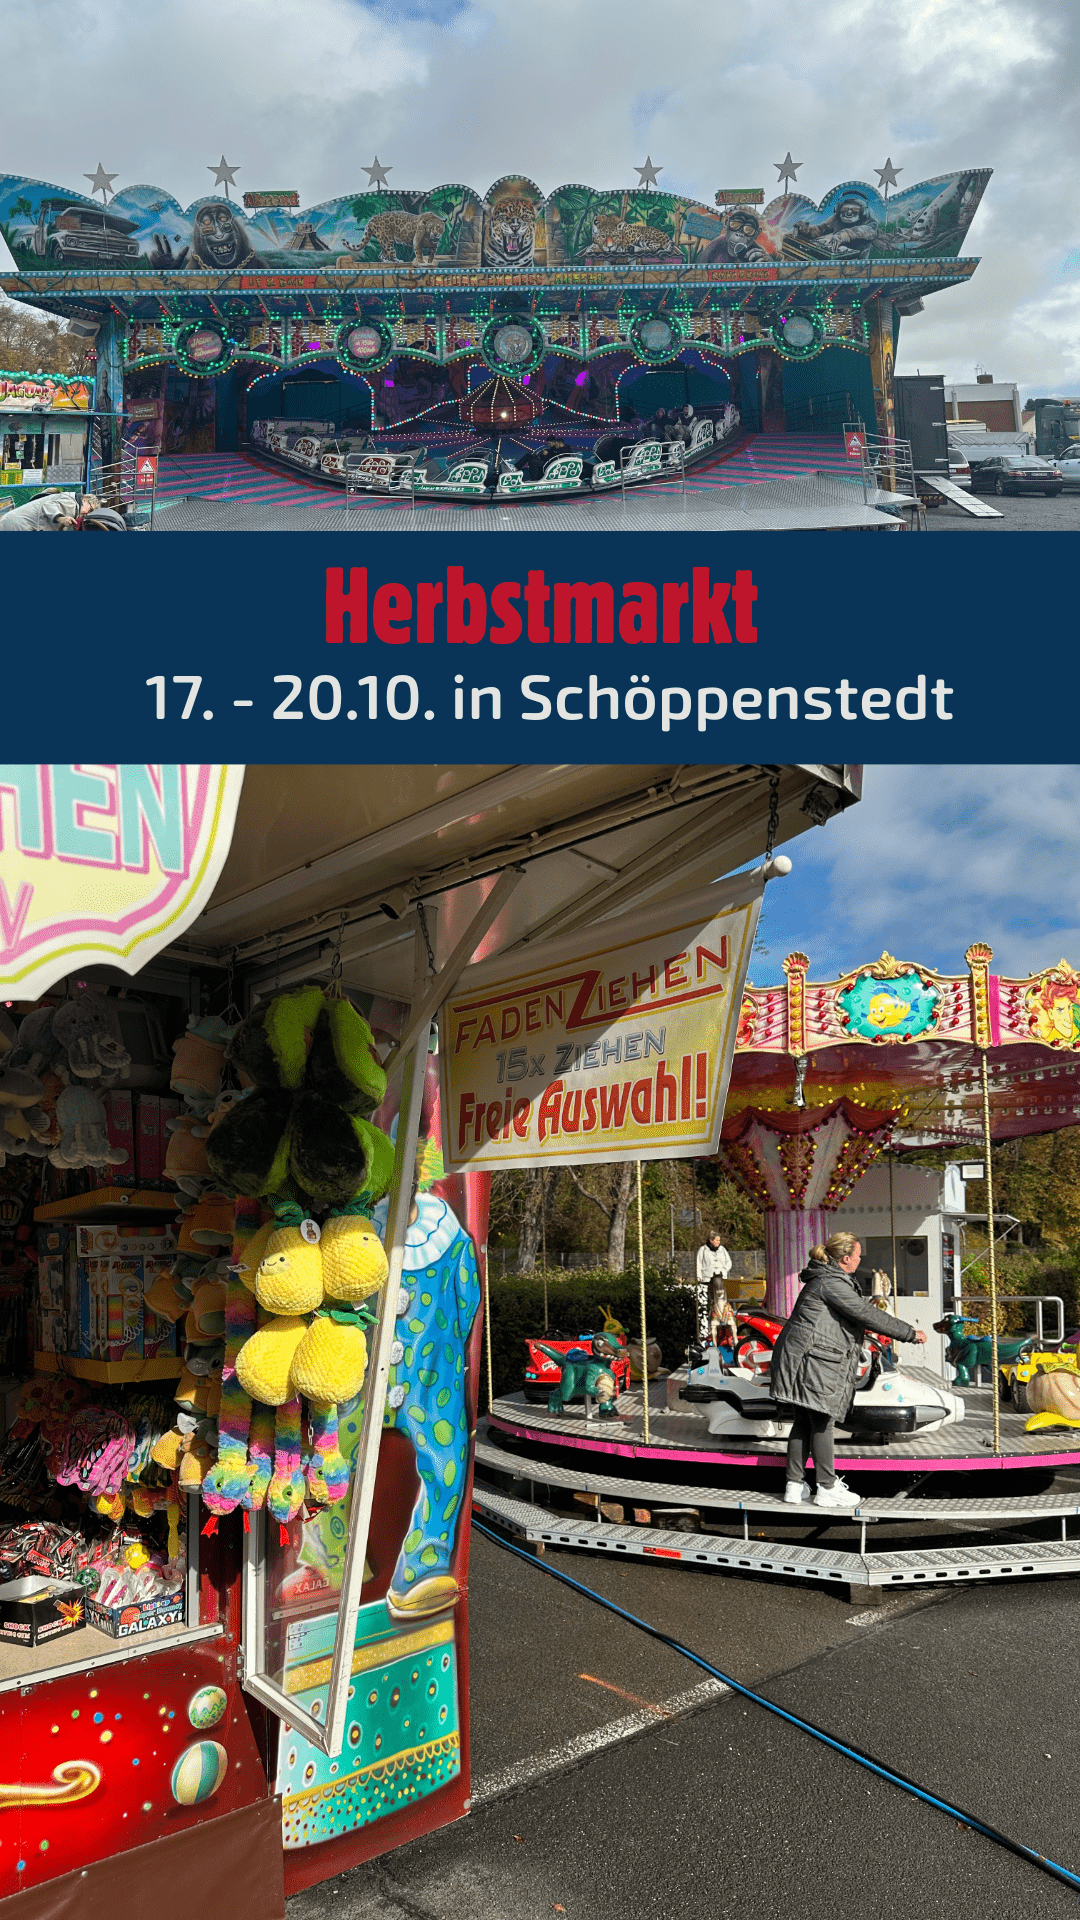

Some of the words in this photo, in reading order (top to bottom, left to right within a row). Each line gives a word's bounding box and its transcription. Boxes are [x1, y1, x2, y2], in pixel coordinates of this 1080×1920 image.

[453, 934, 730, 1055] FADENZIEHEN
[496, 1045, 546, 1083] 15x
[553, 1026, 667, 1074] ZIEHEN
[458, 1086, 532, 1152] Freie
[537, 1052, 708, 1143] Auswahl!
[3, 1621, 32, 1631] SHOCK
[118, 1610, 178, 1637] GALAXY
